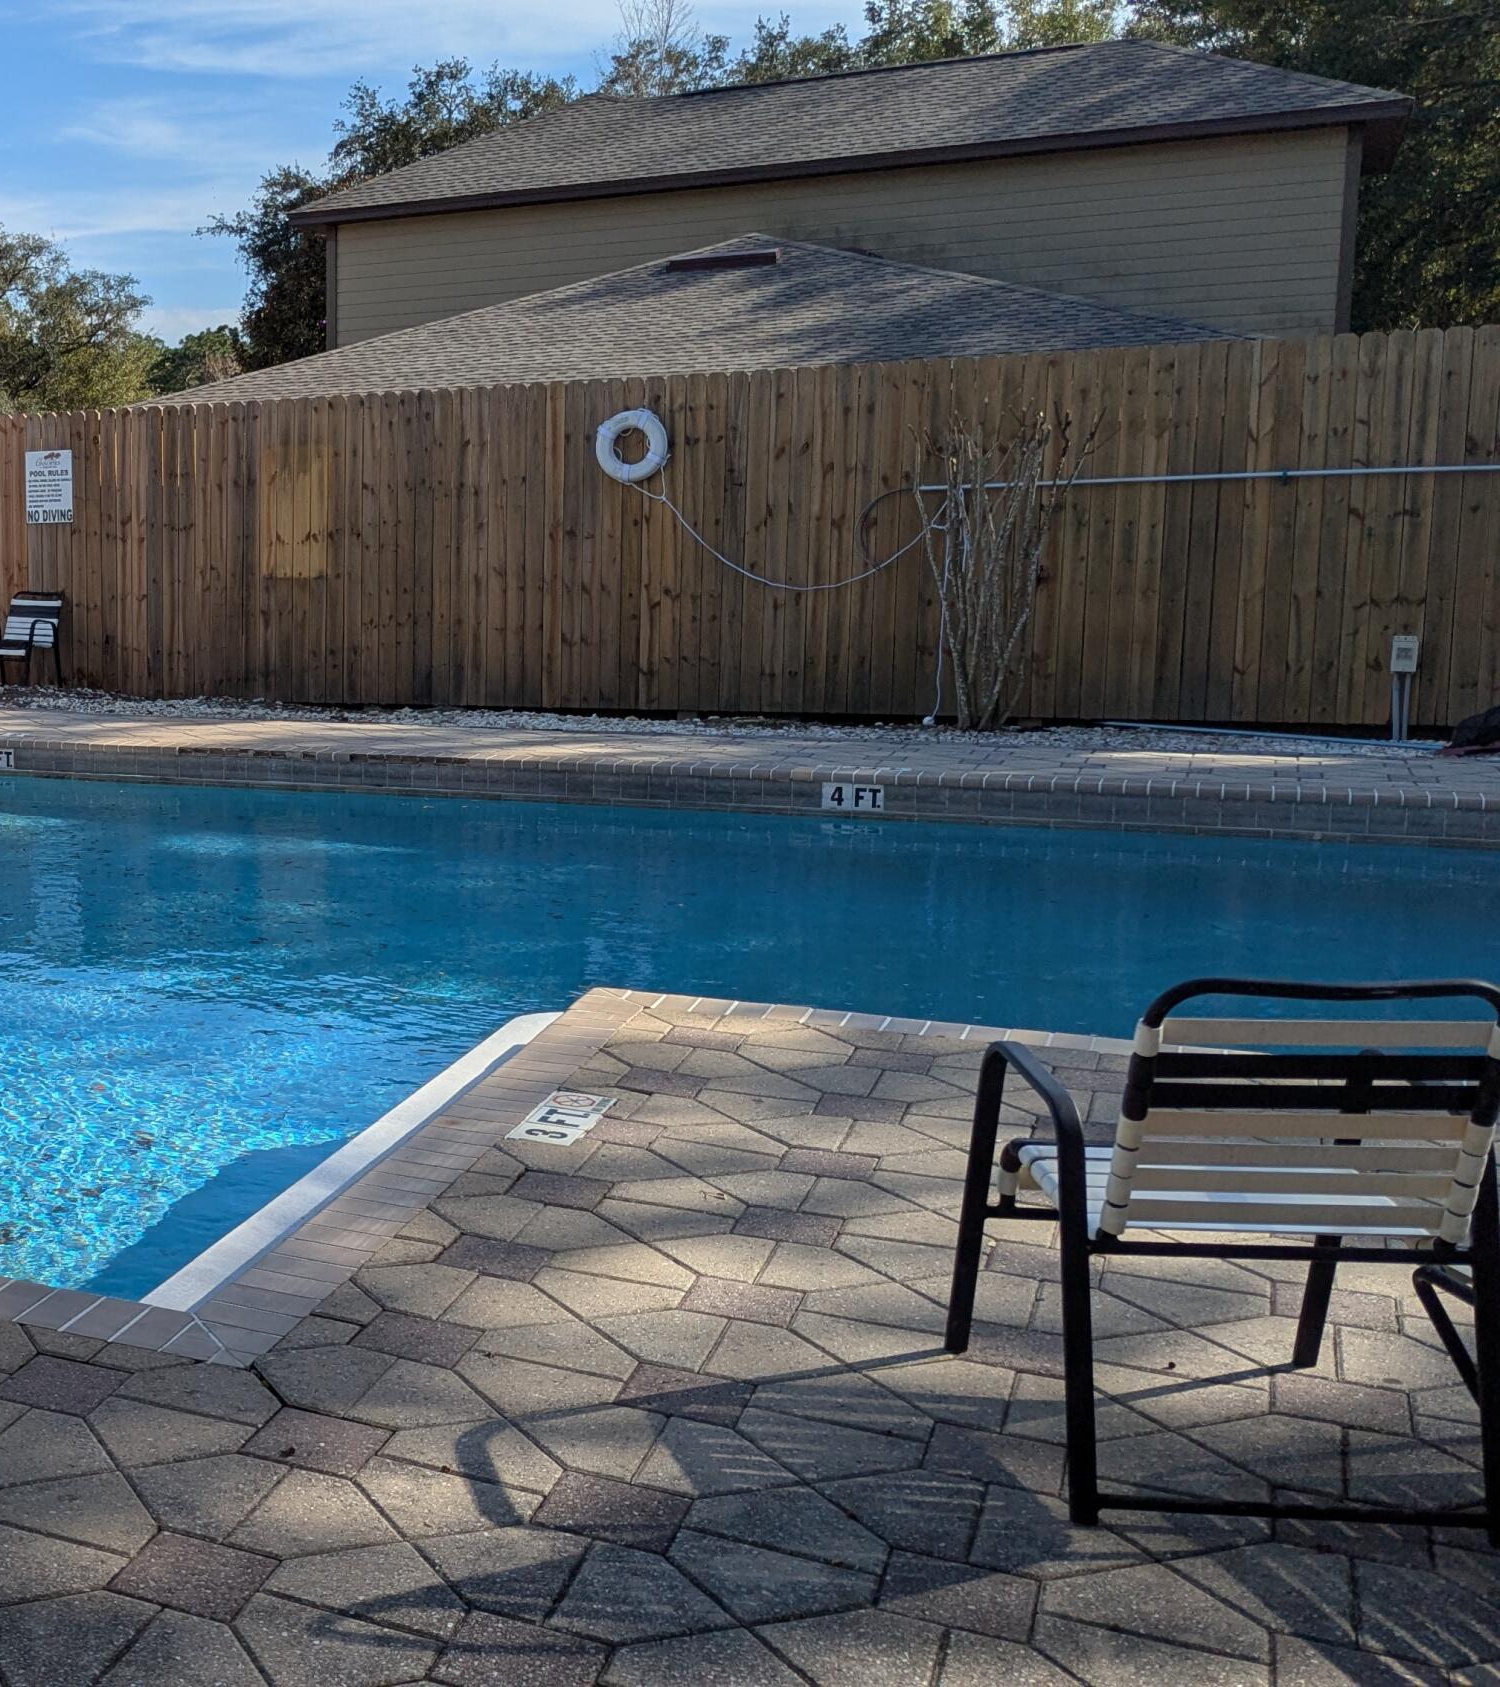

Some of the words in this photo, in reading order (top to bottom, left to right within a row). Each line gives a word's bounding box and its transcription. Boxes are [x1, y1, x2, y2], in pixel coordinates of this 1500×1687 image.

[48, 469, 69, 477] RULES
[28, 510, 40, 522] NO
[42, 509, 73, 522] DIVING
[830, 786, 845, 807] 4
[854, 787, 882, 809] FT.
[525, 1128, 569, 1140] 3
